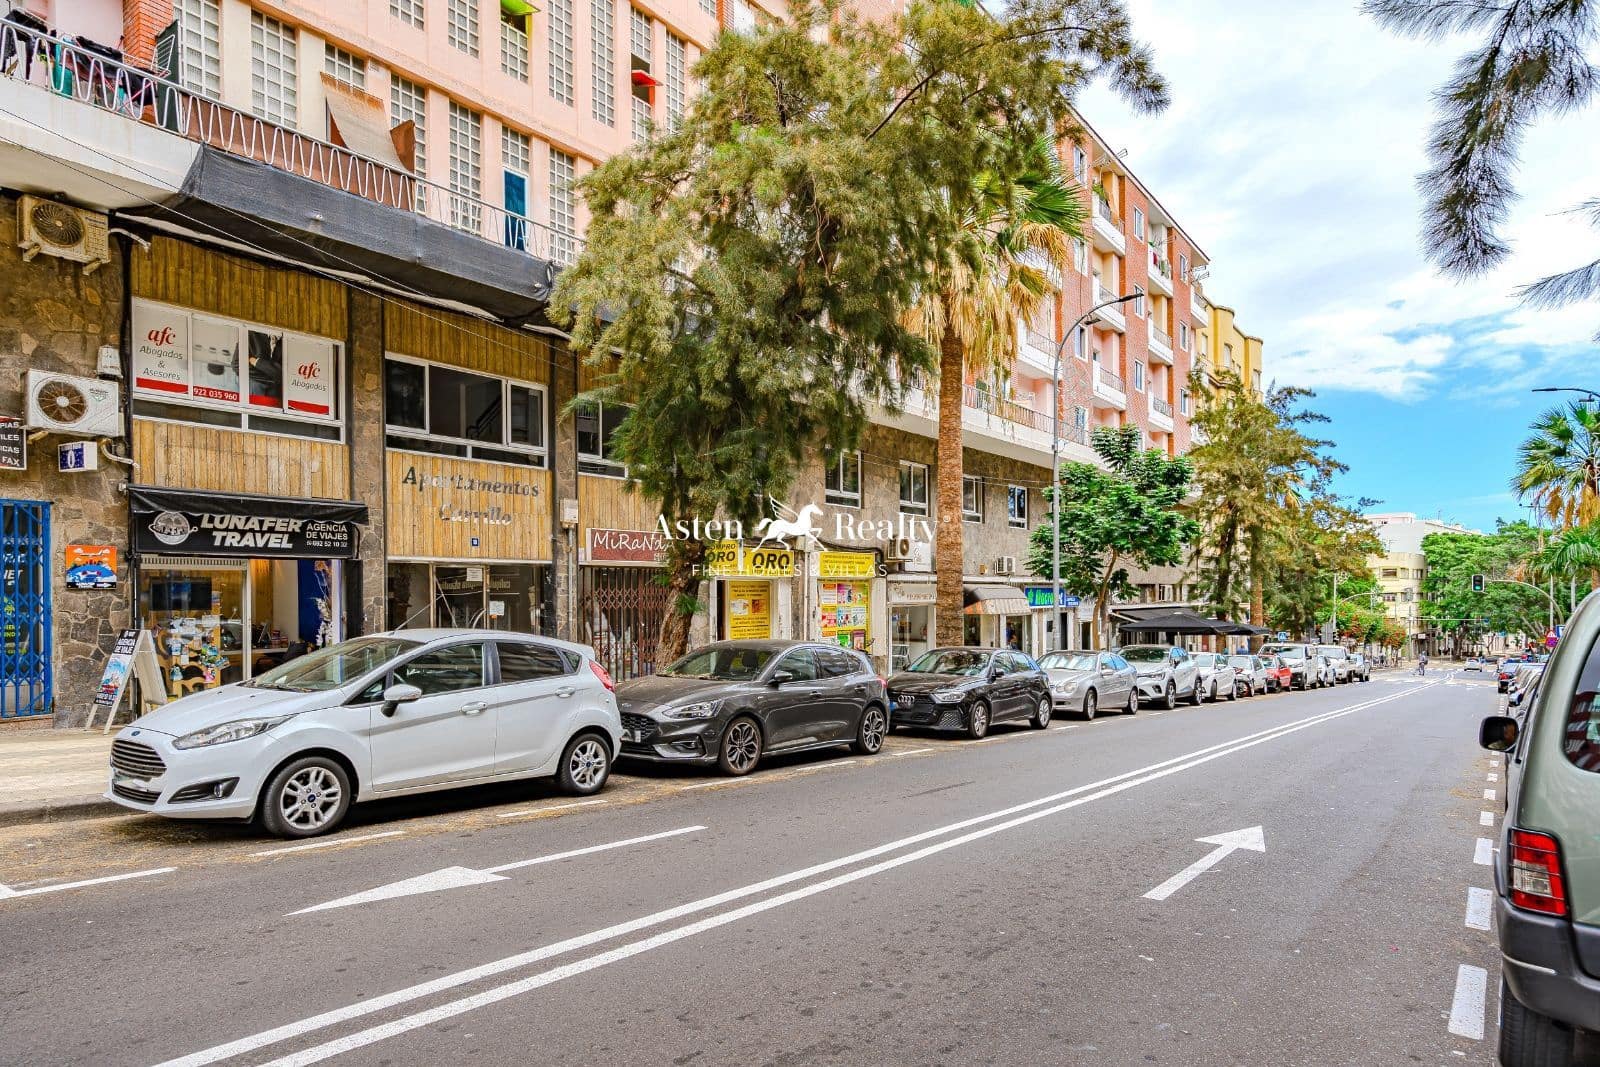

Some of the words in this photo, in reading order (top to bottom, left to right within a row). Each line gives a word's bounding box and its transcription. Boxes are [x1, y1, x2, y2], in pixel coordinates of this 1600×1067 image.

[147, 326, 176, 346] afc
[139, 345, 183, 360] Abogados
[143, 367, 181, 381] Asesores
[298, 361, 321, 380] afc
[291, 379, 327, 392] Abogados
[193, 387, 208, 397] 922
[209, 390, 223, 399] 035
[224, 393, 238, 401] 960
[2, 456, 20, 467] FAX
[402, 466, 540, 497] Apartamentos
[306, 523, 348, 532] AGENCIA
[212, 530, 293, 549] TRAVEL
[306, 531, 318, 539] DE
[320, 532, 348, 541] VIAJES
[752, 552, 790, 570] ORO
